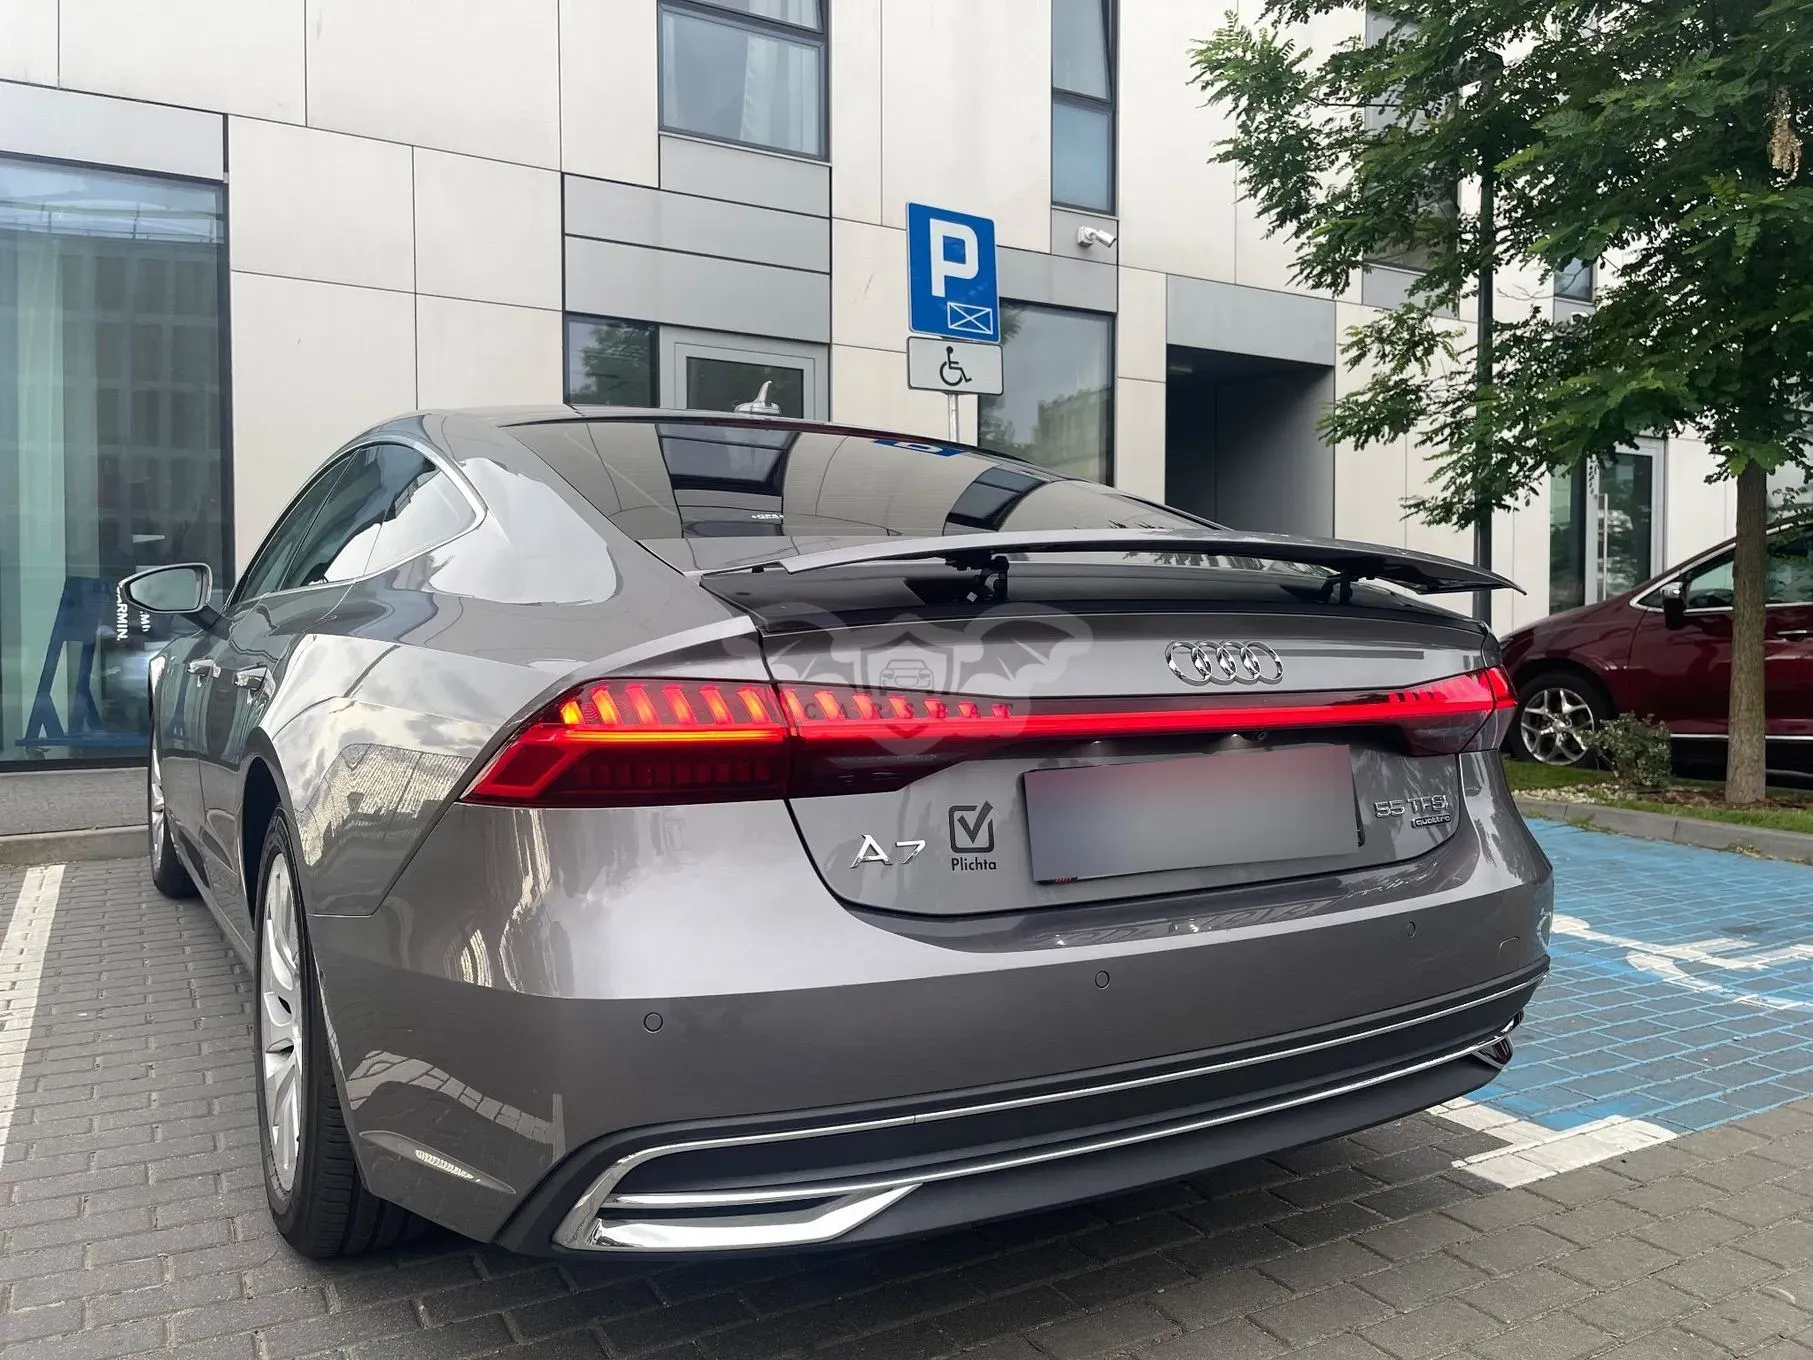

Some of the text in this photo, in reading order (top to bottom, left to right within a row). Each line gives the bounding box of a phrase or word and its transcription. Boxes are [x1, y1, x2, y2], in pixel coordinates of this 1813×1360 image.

[929, 218, 979, 298] P
[1374, 794, 1449, 818] 55 TFSI
[1415, 815, 1451, 826] quattro
[850, 834, 926, 869] A7
[951, 857, 997, 871] Plichta
